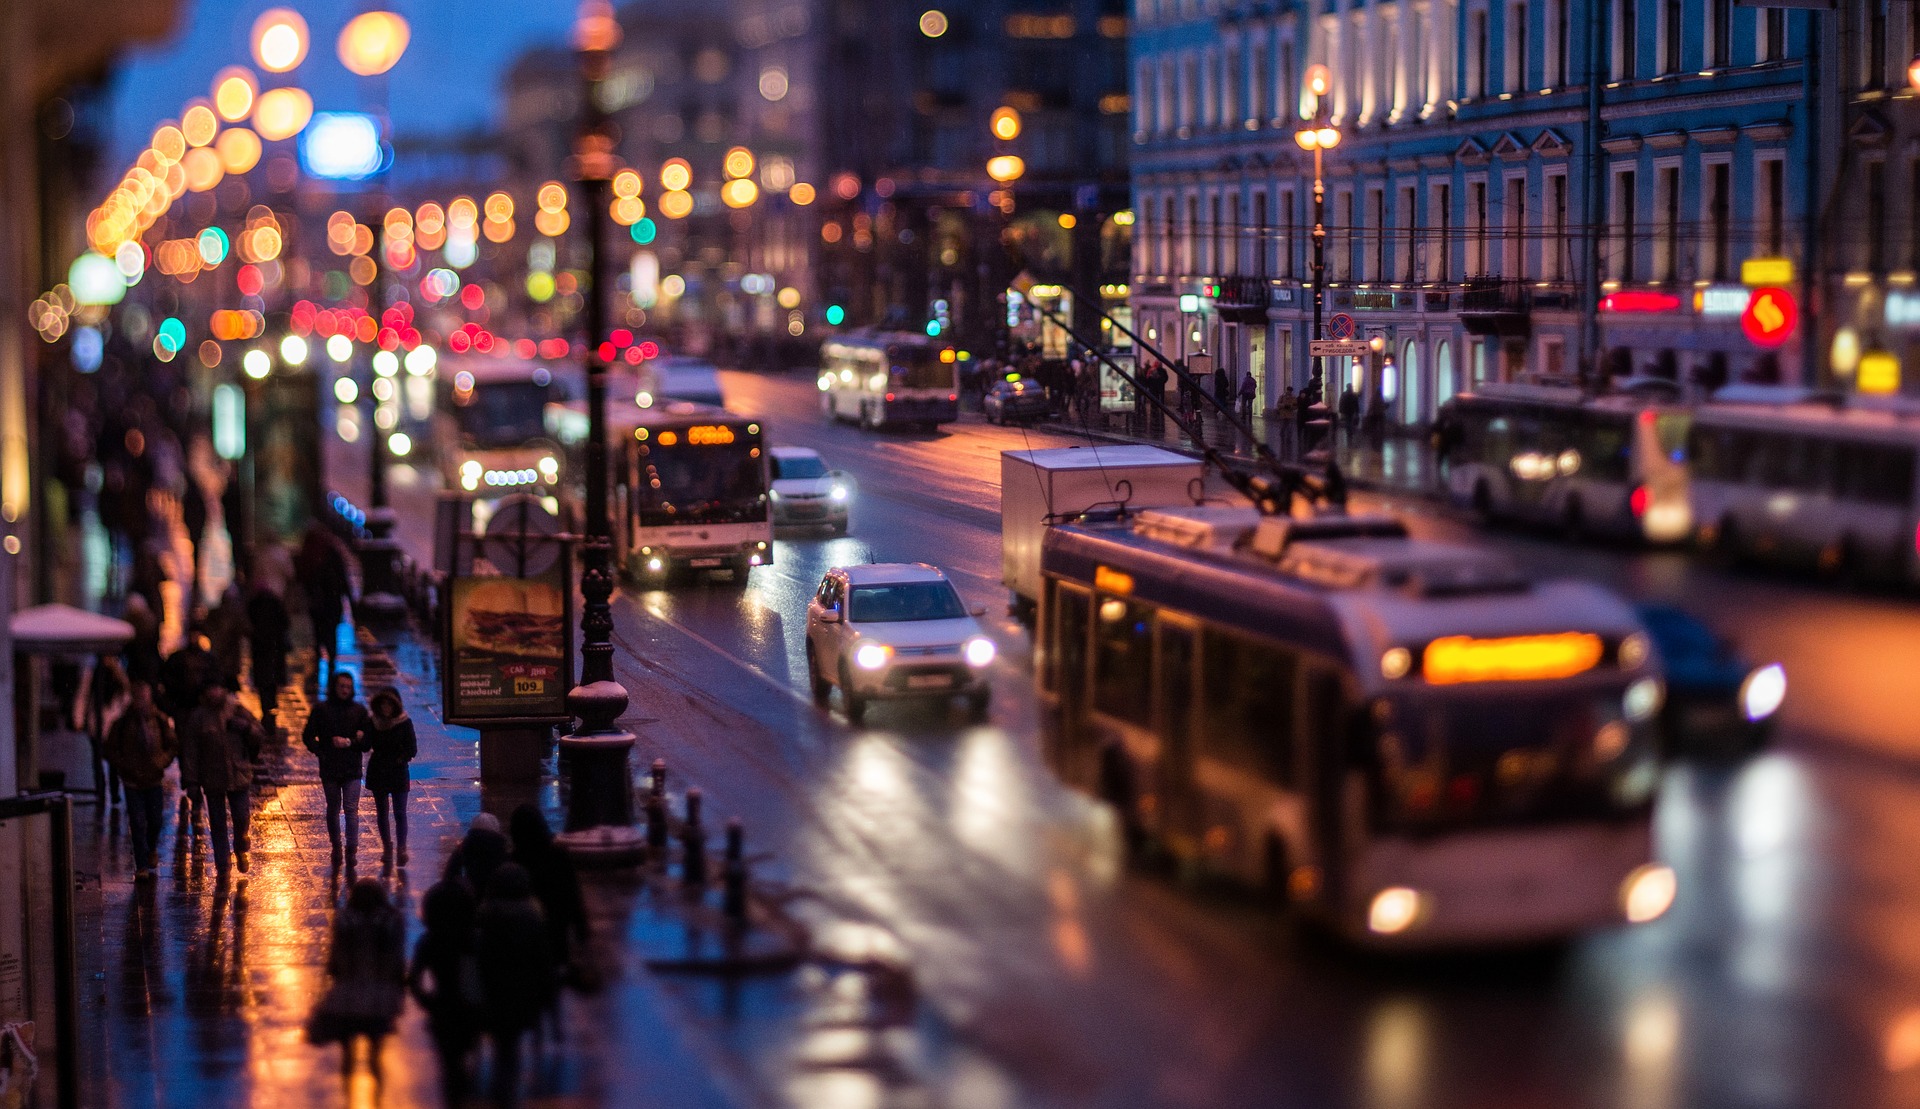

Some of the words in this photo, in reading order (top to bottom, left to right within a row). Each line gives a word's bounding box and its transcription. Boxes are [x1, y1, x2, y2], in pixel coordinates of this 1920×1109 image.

[530, 667, 547, 677] ДНЯ
[460, 687, 502, 696] сэндвич!
[516, 681, 537, 692] 109
